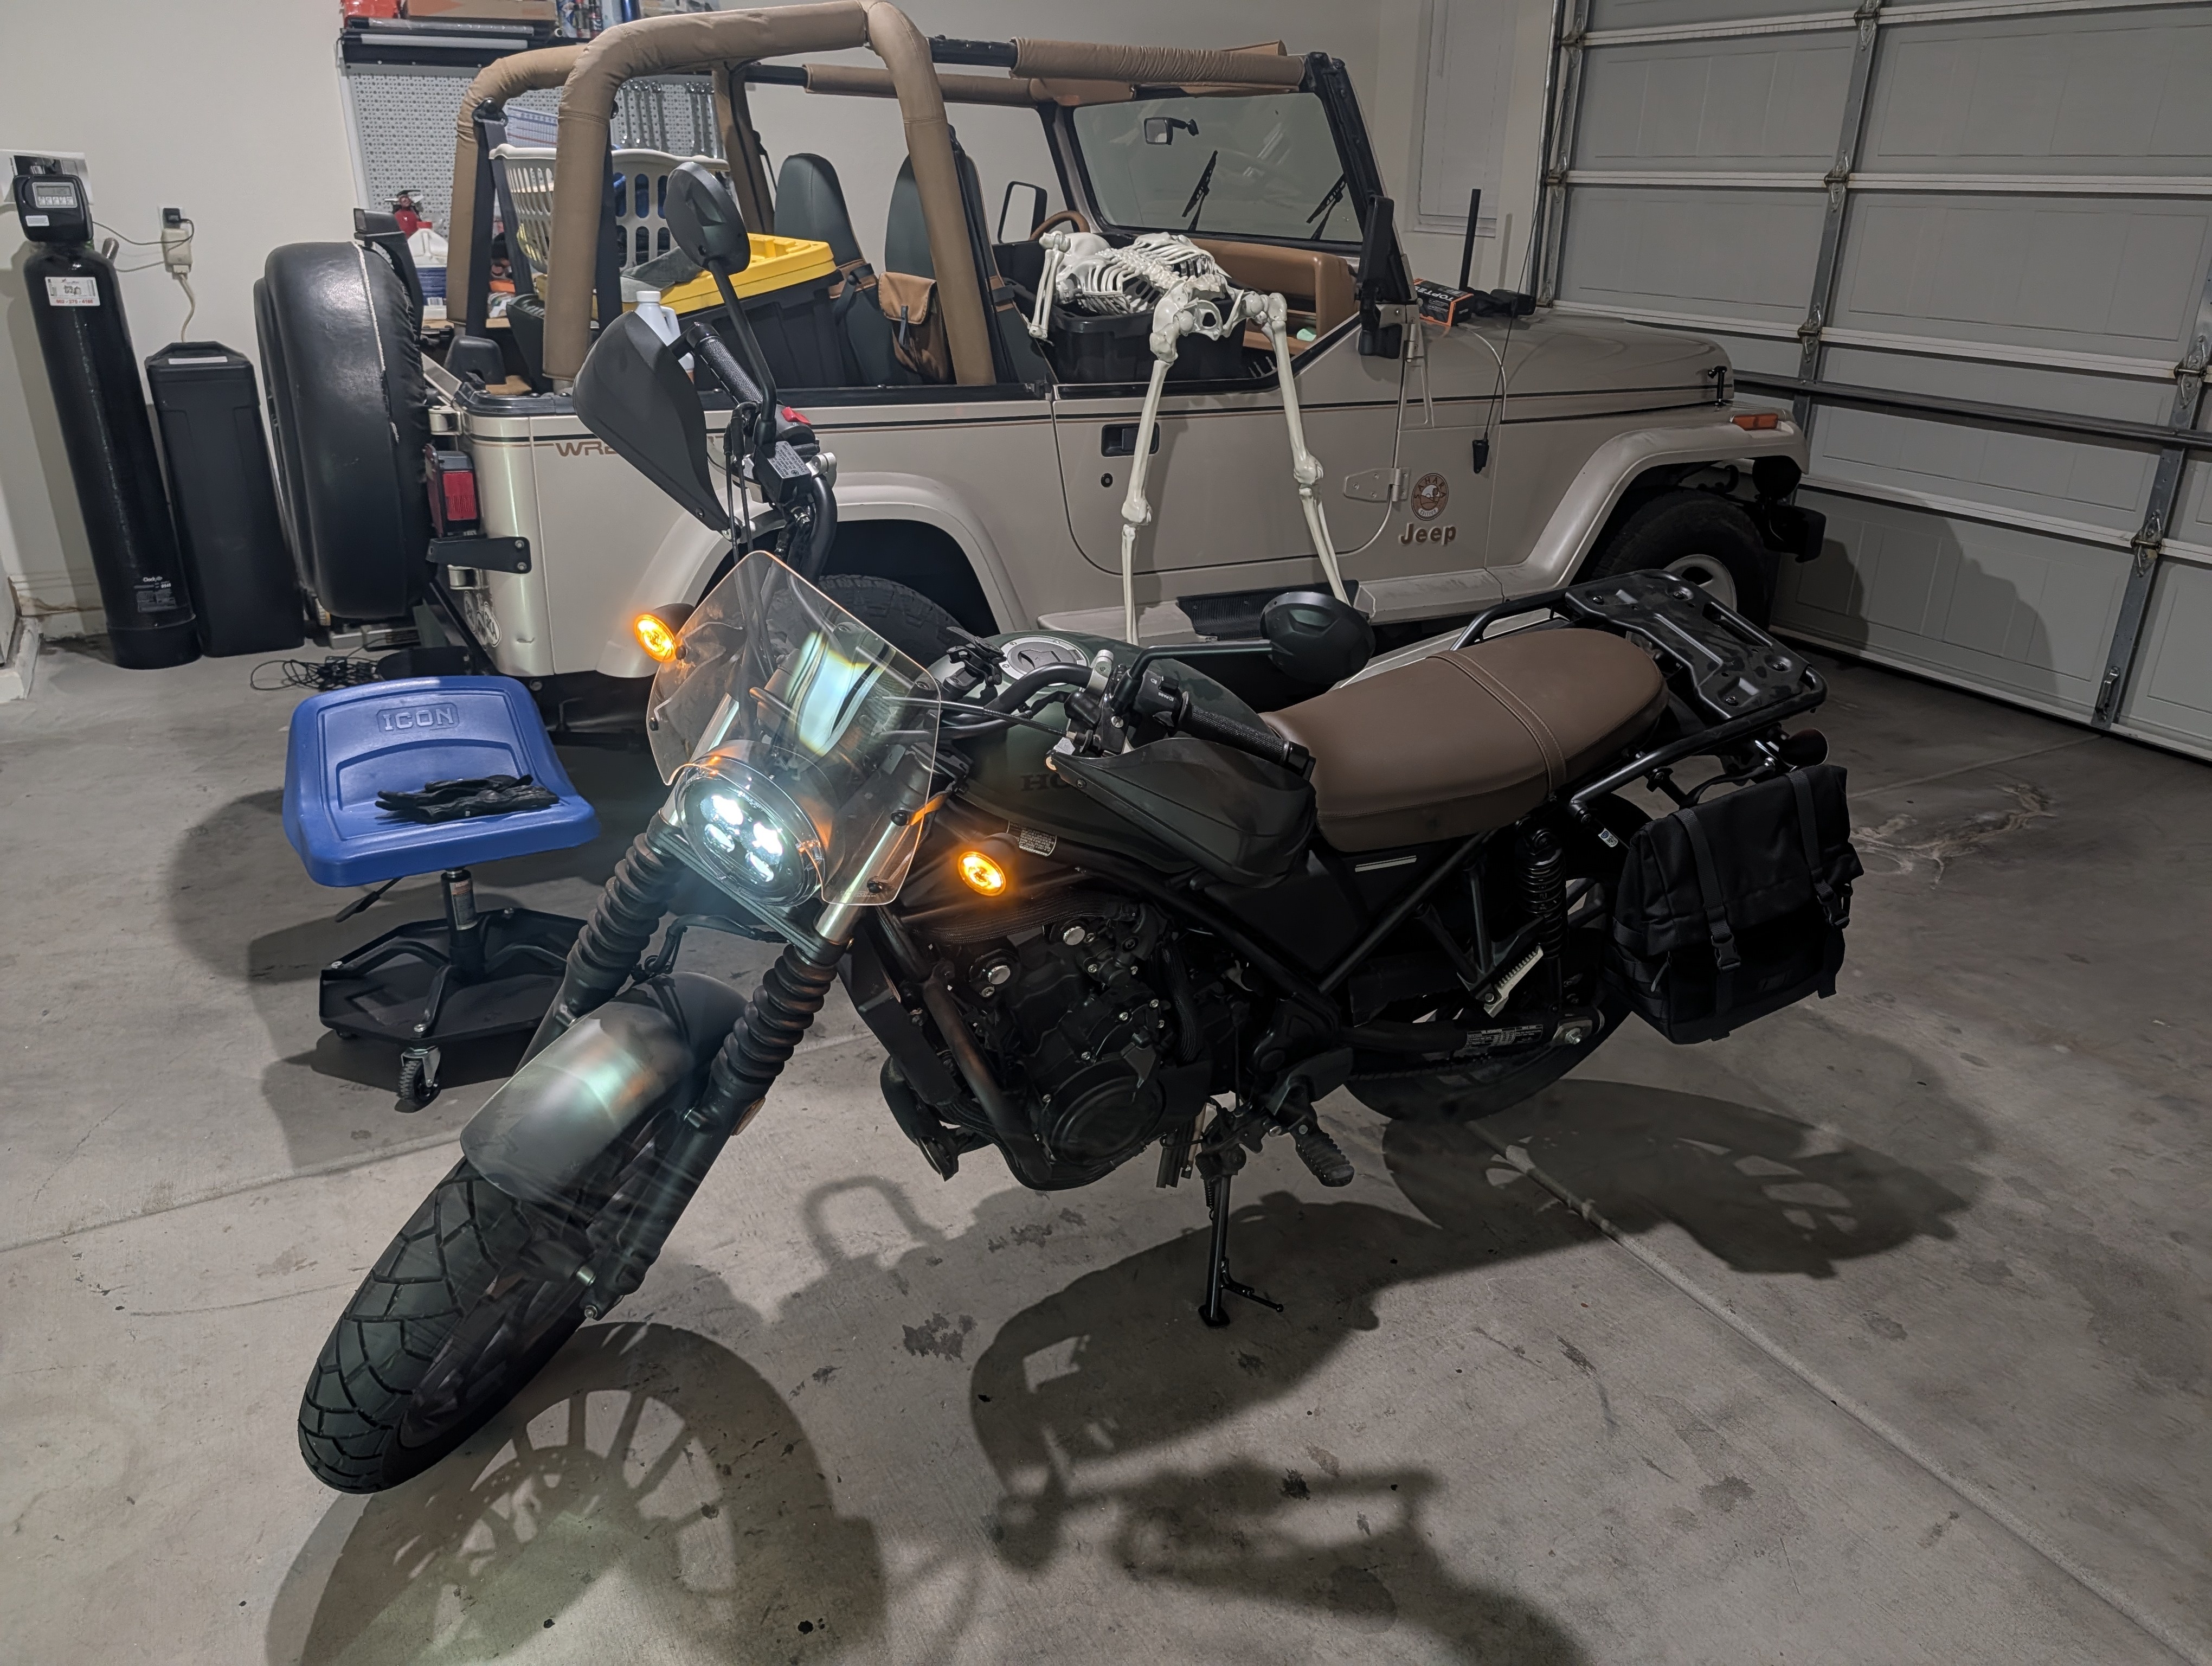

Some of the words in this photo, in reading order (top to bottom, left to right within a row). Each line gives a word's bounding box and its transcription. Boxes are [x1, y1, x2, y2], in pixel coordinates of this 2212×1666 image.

[1413, 477, 1446, 499] SAHARA
[1398, 523, 1456, 546] Jeep
[383, 708, 454, 731] ICON
